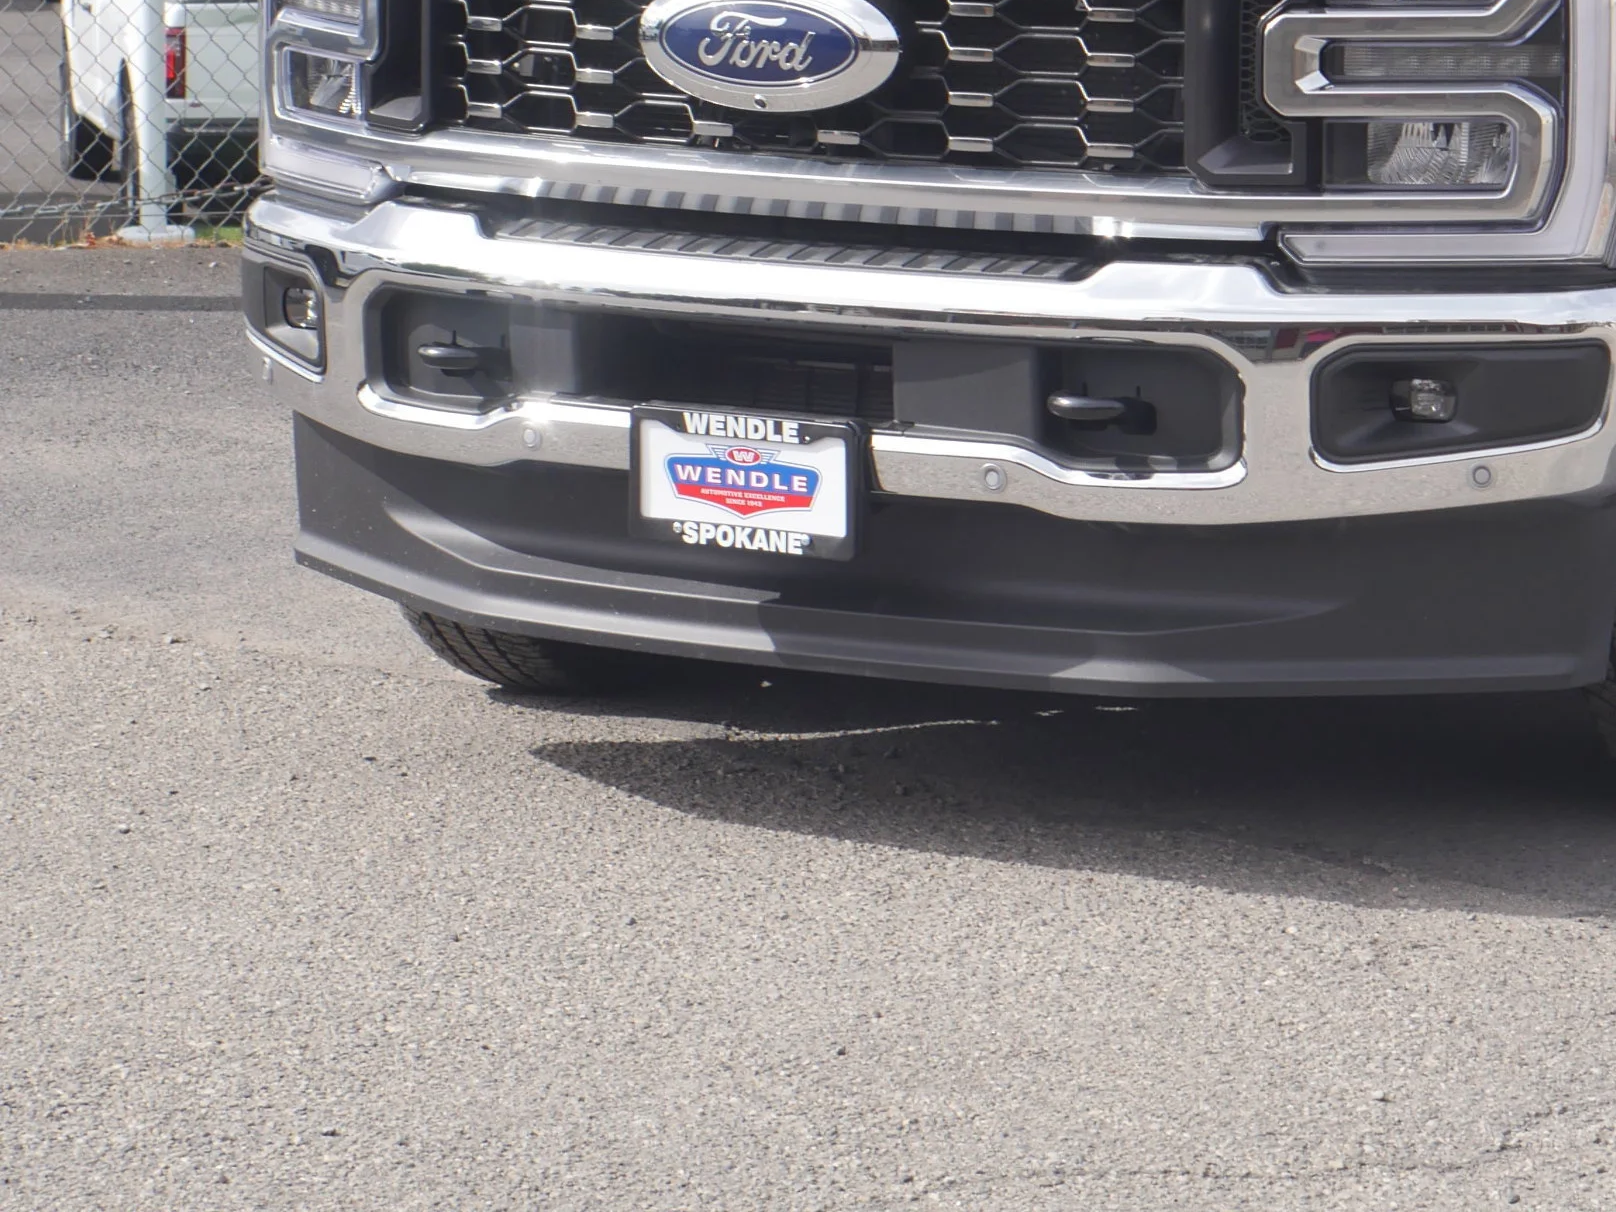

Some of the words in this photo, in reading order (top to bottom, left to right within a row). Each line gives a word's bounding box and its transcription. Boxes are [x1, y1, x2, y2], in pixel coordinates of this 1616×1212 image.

[697, 10, 817, 72] Ford
[683, 411, 800, 444] WENDLE
[674, 463, 809, 493] WENDLE
[681, 521, 804, 556] SPOKANE
